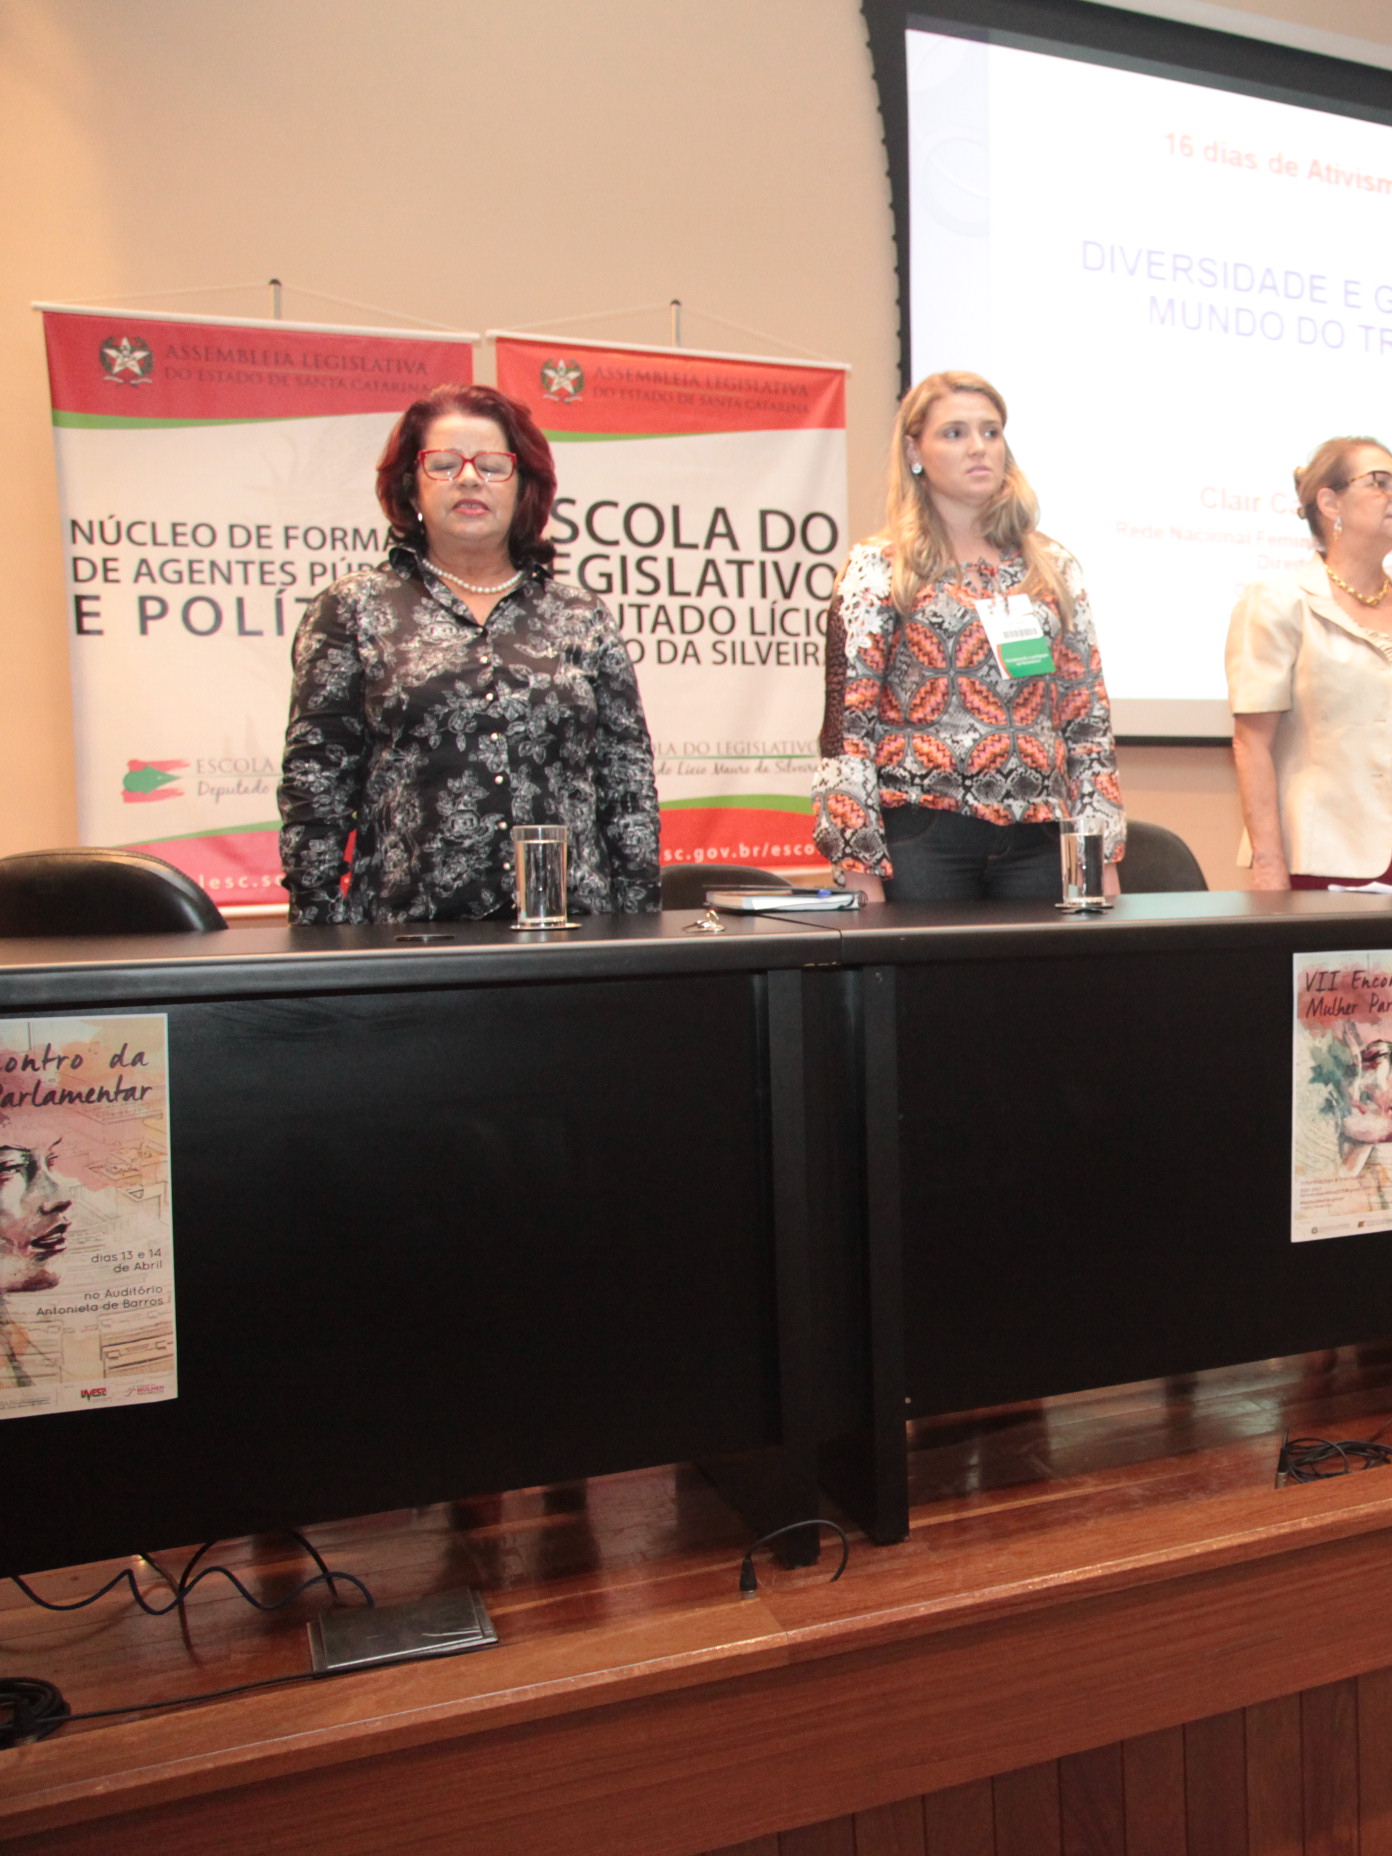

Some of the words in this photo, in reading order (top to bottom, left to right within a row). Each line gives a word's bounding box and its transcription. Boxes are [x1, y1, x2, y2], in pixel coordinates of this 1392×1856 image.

[1166, 132, 1194, 158] 16
[1204, 140, 1257, 169] dias
[1269, 152, 1298, 177] de
[1082, 241, 1327, 304] DIVERSIDADE
[1344, 280, 1361, 309] E
[1149, 296, 1284, 341] MUNDO
[1298, 316, 1345, 349] DO
[165, 343, 294, 367] ASSEMBLEIA
[302, 352, 428, 376] LEGISLATIVA
[164, 366, 192, 380] DO
[198, 369, 262, 386] ESTADO
[1200, 486, 1263, 512] Clair
[70, 514, 217, 548] NÚCLEO
[228, 524, 273, 549] DE
[759, 509, 839, 555] DO
[72, 557, 121, 584] DE
[133, 558, 297, 587] AGENTES
[74, 594, 104, 636] E
[138, 588, 313, 637] POLÍ
[657, 639, 702, 665] DA
[712, 640, 826, 667] SILVEIR
[683, 740, 711, 757] DO
[196, 756, 275, 775] ESCOLA
[198, 778, 270, 805] Deputado
[663, 842, 821, 863] sc.gov.br/esco
[1305, 969, 1340, 992] VII
[1306, 997, 1359, 1019] Mulher
[0, 1042, 84, 1074] ontro
[110, 1042, 149, 1070] da
[91, 1253, 118, 1264] dias
[121, 1251, 134, 1261] 13
[137, 1252, 145, 1260] e
[149, 1248, 162, 1258] 14
[114, 1262, 130, 1274] de
[134, 1260, 163, 1271] Abril
[84, 1291, 100, 1301] no
[105, 1285, 163, 1299] Auditório
[37, 1303, 99, 1317] Antonieta
[103, 1300, 119, 1311] de
[123, 1297, 164, 1309] Barros
